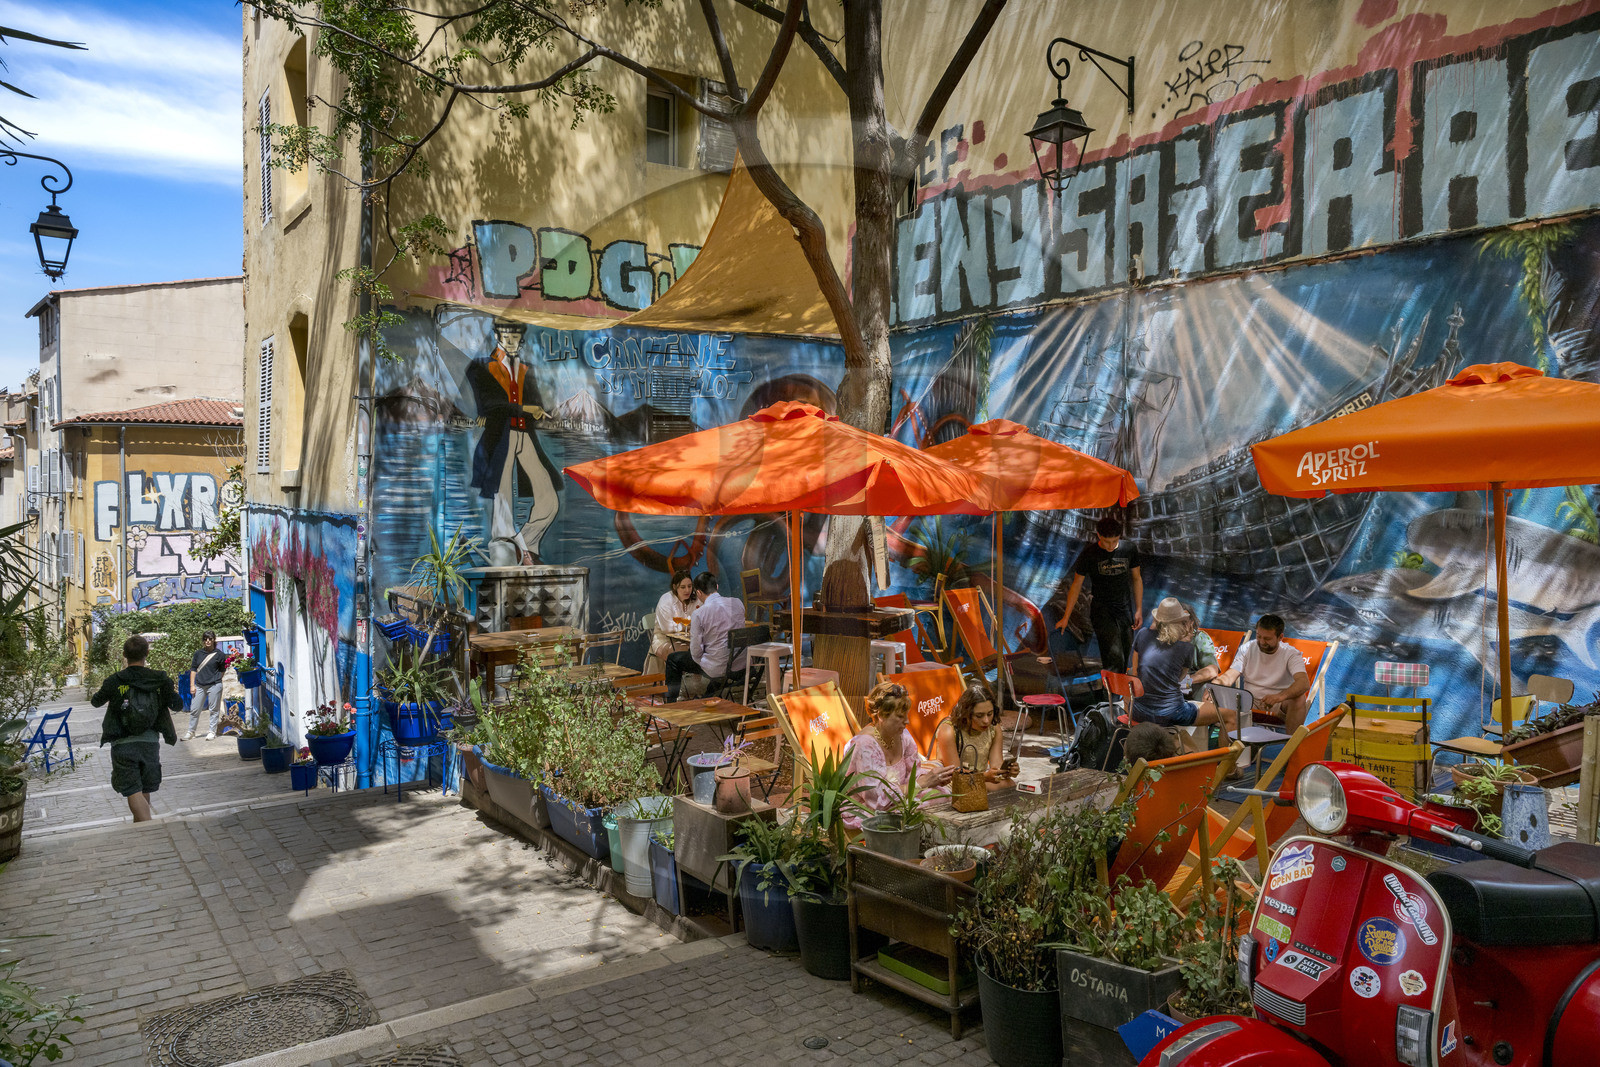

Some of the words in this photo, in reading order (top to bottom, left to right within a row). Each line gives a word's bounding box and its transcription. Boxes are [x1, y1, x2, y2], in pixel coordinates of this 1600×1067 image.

[540, 330, 579, 361] LA
[593, 372, 626, 395] DU
[1296, 440, 1381, 478] APEROL
[917, 696, 945, 713] APEROL
[1368, 762, 1396, 775] TANTE
[1271, 872, 1292, 888] OPEN
[1293, 866, 1313, 879] BAR
[1264, 895, 1296, 916] vespa
[1297, 963, 1318, 976] CREW
[1301, 958, 1322, 971] SALTY
